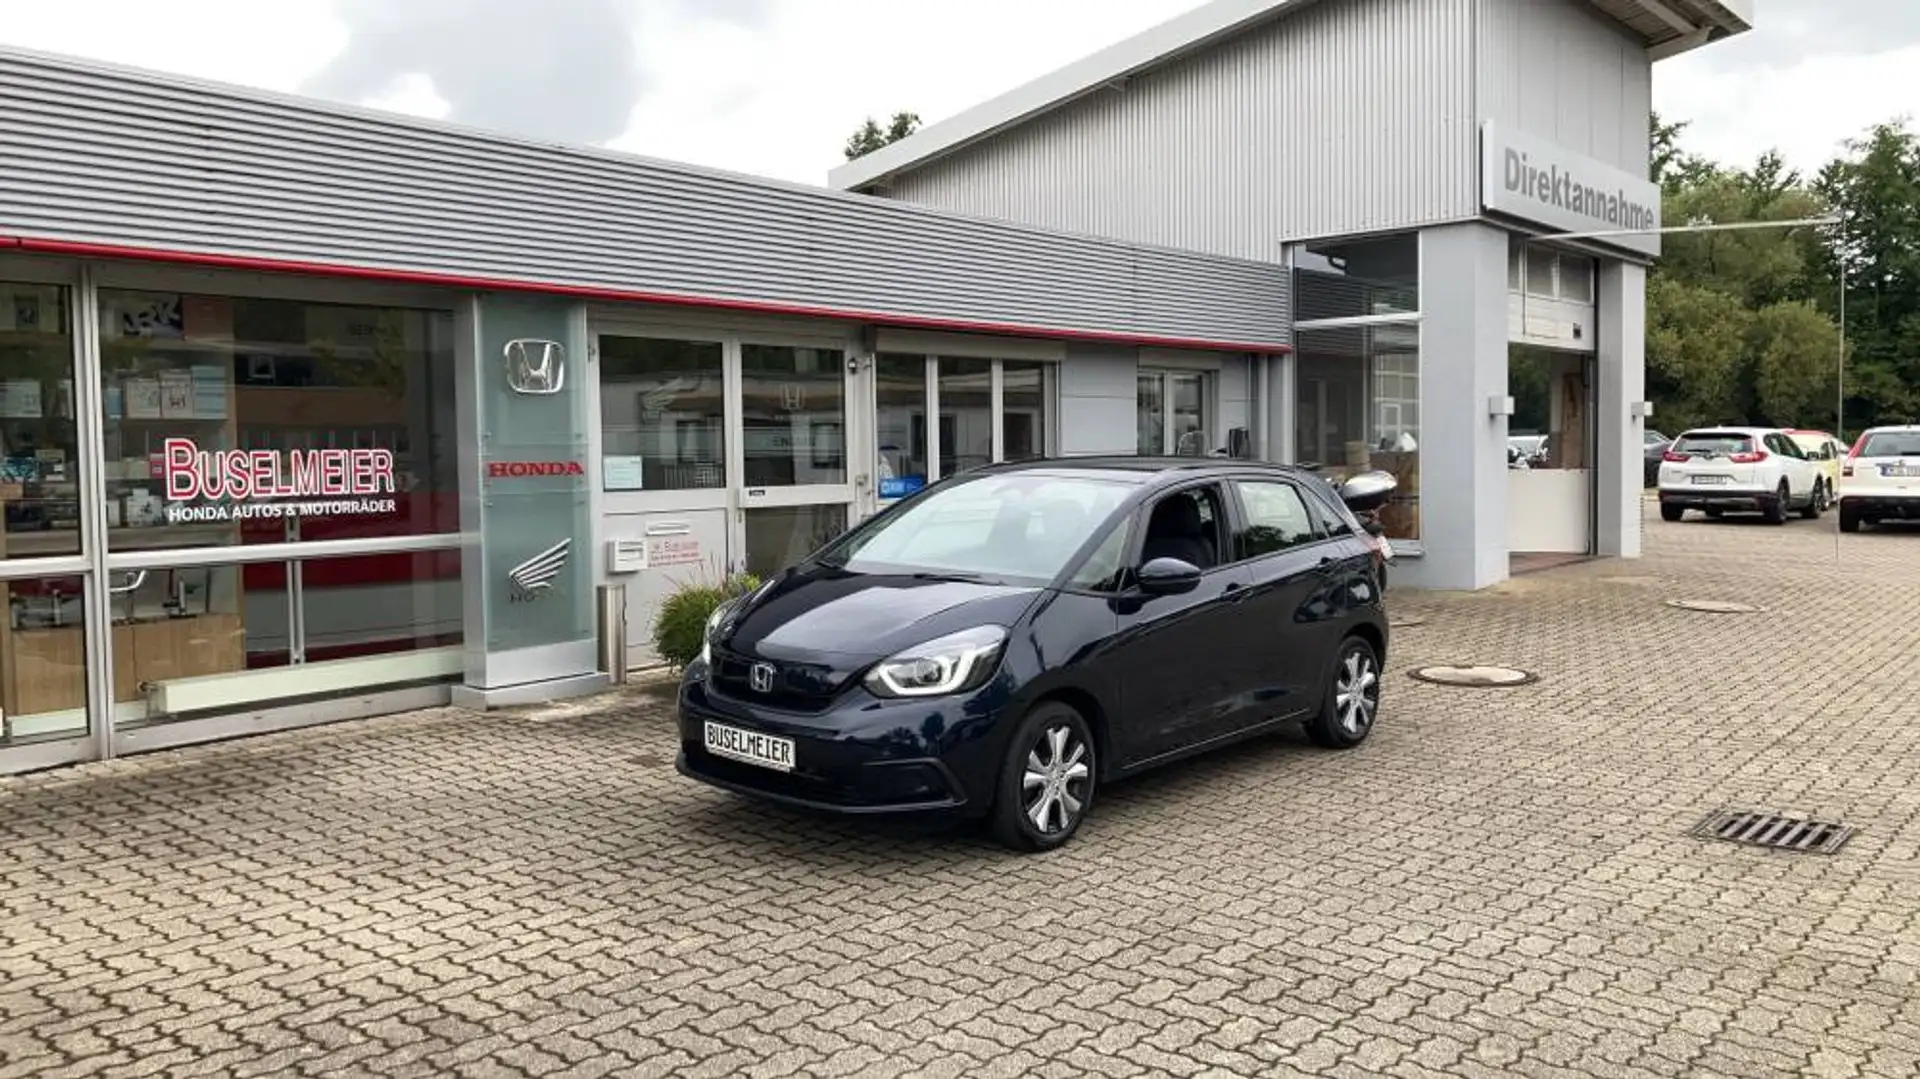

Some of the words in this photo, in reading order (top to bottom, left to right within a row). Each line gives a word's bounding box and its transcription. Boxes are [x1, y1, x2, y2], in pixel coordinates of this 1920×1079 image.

[1505, 146, 1655, 230] Direktannahme
[164, 438, 396, 500] BUSELMEIER
[487, 461, 585, 478] HONDA
[168, 506, 229, 523] HONDA
[232, 502, 282, 519] AUTOS
[285, 502, 297, 517] &
[301, 498, 397, 516] MOTORRÄDER
[706, 723, 791, 764] BUSELMEIER
